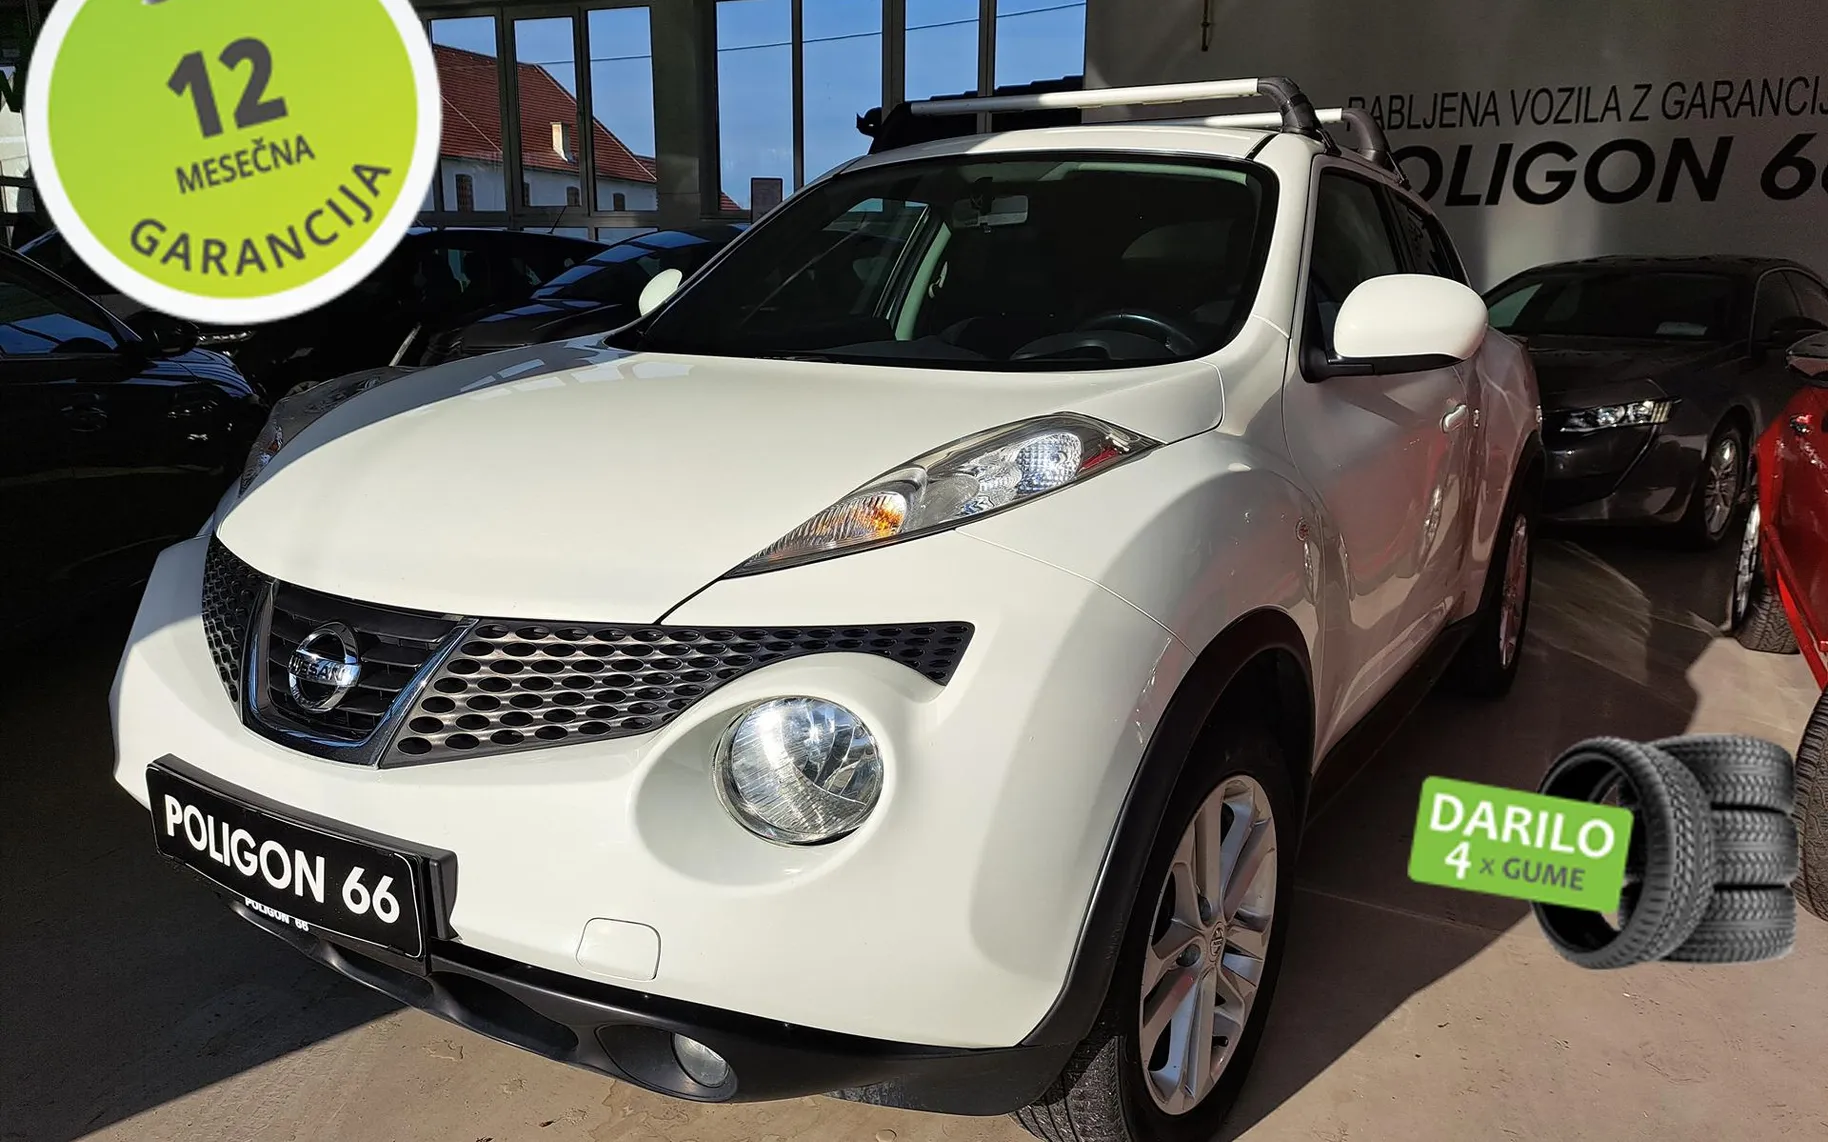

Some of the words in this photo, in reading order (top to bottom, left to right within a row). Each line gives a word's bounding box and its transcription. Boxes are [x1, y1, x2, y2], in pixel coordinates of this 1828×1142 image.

[1510, 85, 1622, 126] VOZILA
[1628, 83, 1652, 122] Z
[1392, 135, 1734, 207] OLIGON
[164, 794, 325, 903] POLIGON
[342, 866, 400, 924] 66
[244, 897, 290, 924] POLIGON
